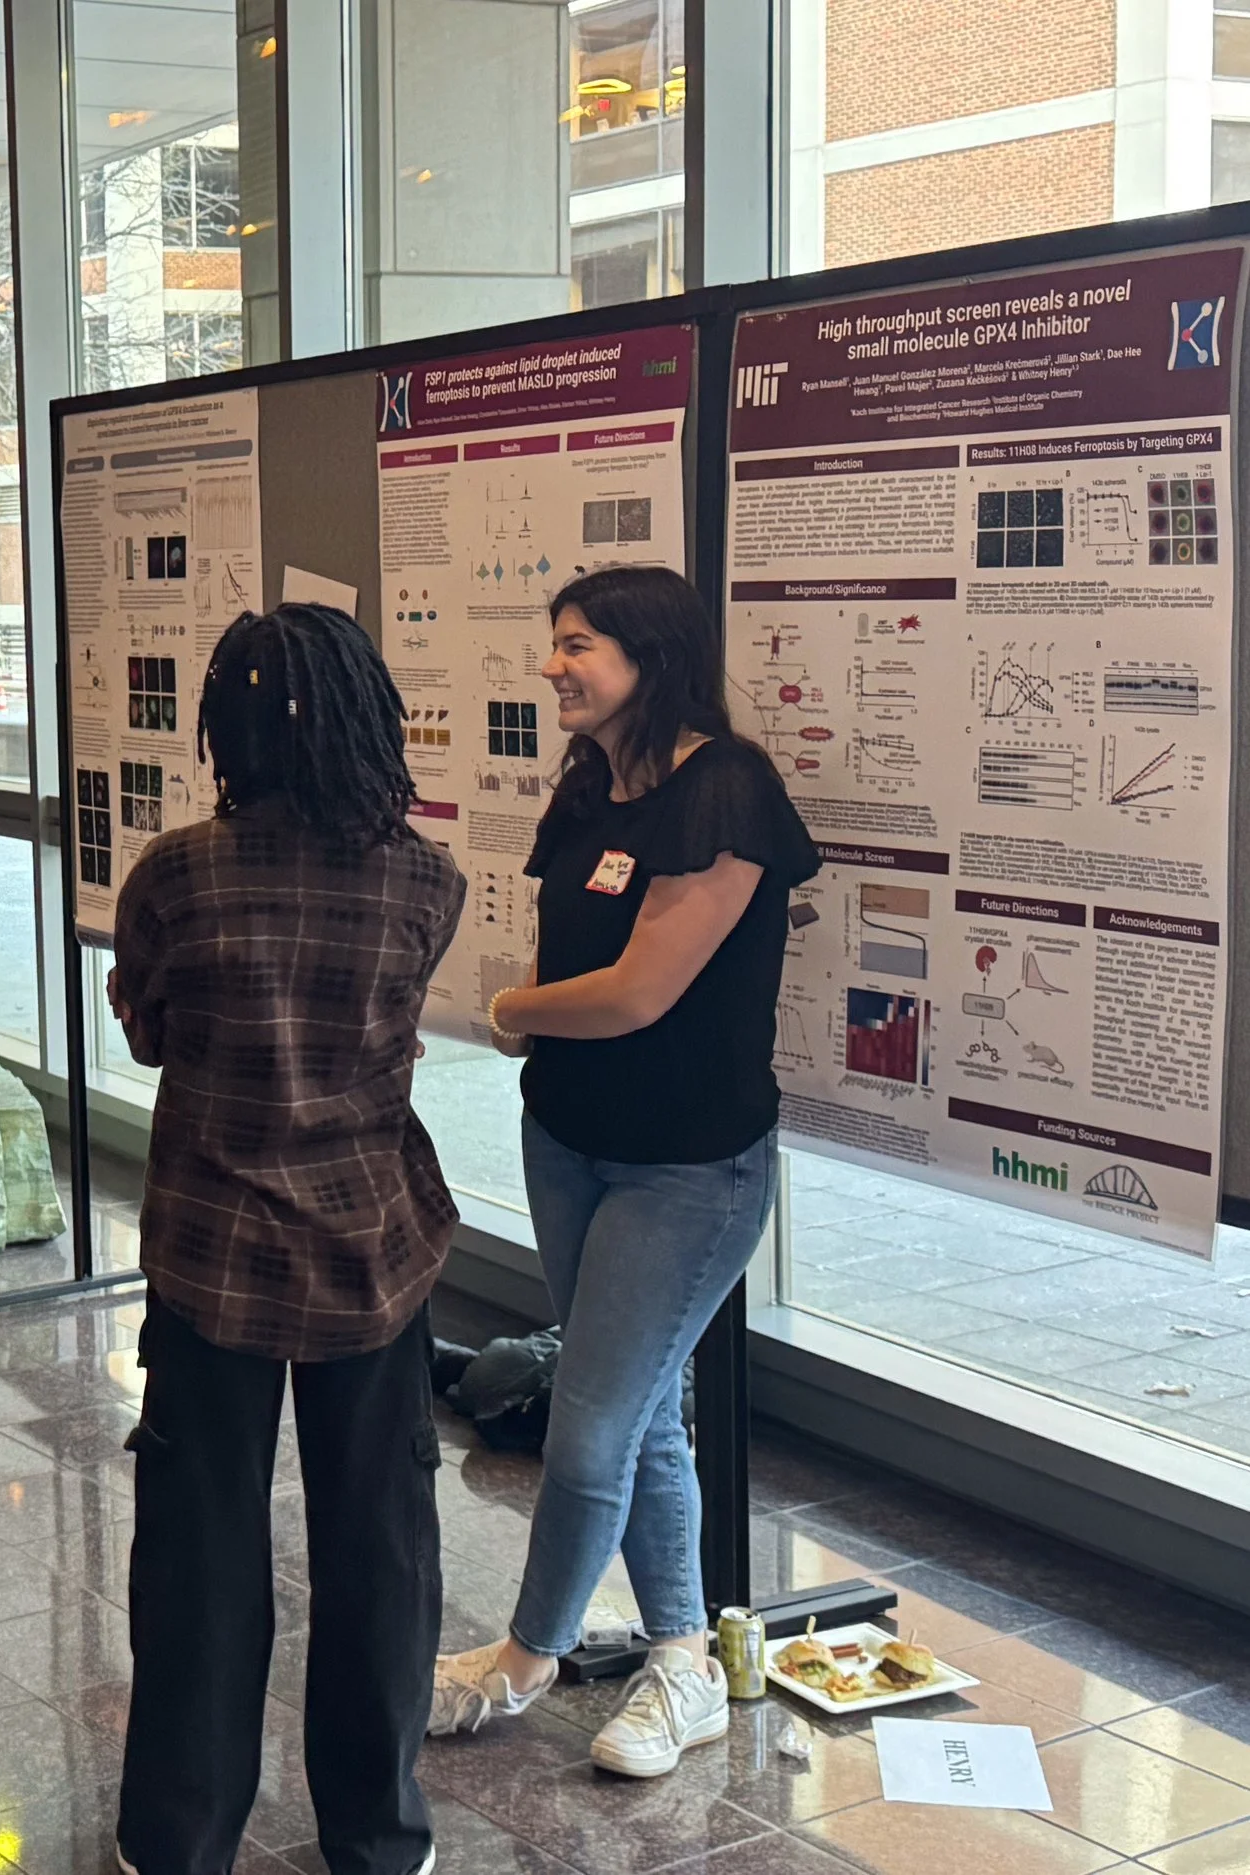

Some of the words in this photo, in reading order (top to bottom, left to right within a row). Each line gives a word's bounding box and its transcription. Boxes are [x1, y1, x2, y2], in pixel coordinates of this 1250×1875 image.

[818, 317, 851, 342] High
[856, 310, 941, 335] throughput
[946, 300, 1001, 324] screen
[1005, 289, 1063, 315] reveals
[1069, 292, 1078, 308] a
[1083, 279, 1132, 303] novel
[848, 337, 888, 360] small
[893, 328, 969, 355] molecule
[973, 322, 1017, 346] GPX4
[1021, 315, 1091, 340] Inhibitor
[425, 372, 446, 386] FSP1
[448, 366, 483, 386] protects
[485, 360, 518, 380] against
[519, 357, 540, 374] lipid
[542, 354, 577, 371] droplet
[579, 344, 622, 364] induced
[853, 376, 870, 385] Juan
[872, 372, 899, 383] Manuel
[1107, 349, 1123, 359] Dae
[1125, 347, 1142, 357] Hee
[426, 385, 470, 404] ferroptosis
[472, 385, 481, 398] to
[482, 379, 516, 399] prevent
[518, 373, 553, 390] MASLD
[555, 366, 617, 389] progression
[972, 446, 1007, 460] Results:
[1008, 445, 1037, 457] 11H08
[1038, 442, 1072, 456] Induces
[1074, 439, 1124, 455] Ferroptosis
[1126, 438, 1138, 452] by
[1139, 435, 1184, 450] Targeting
[1186, 433, 1213, 446] GPX4
[814, 458, 863, 471] Introduction
[785, 584, 887, 598] Background/Significance
[825, 847, 863, 862] Molecule
[865, 851, 895, 864] Screen
[981, 898, 1010, 912] Future
[1012, 901, 1059, 918] Directions
[1109, 913, 1203, 937] Acknowledgements
[1038, 1120, 1076, 1139] Funding
[1078, 1128, 1117, 1147] Sources
[992, 1146, 1068, 1192] hhmi
[943, 1739, 976, 1787] HENRY
